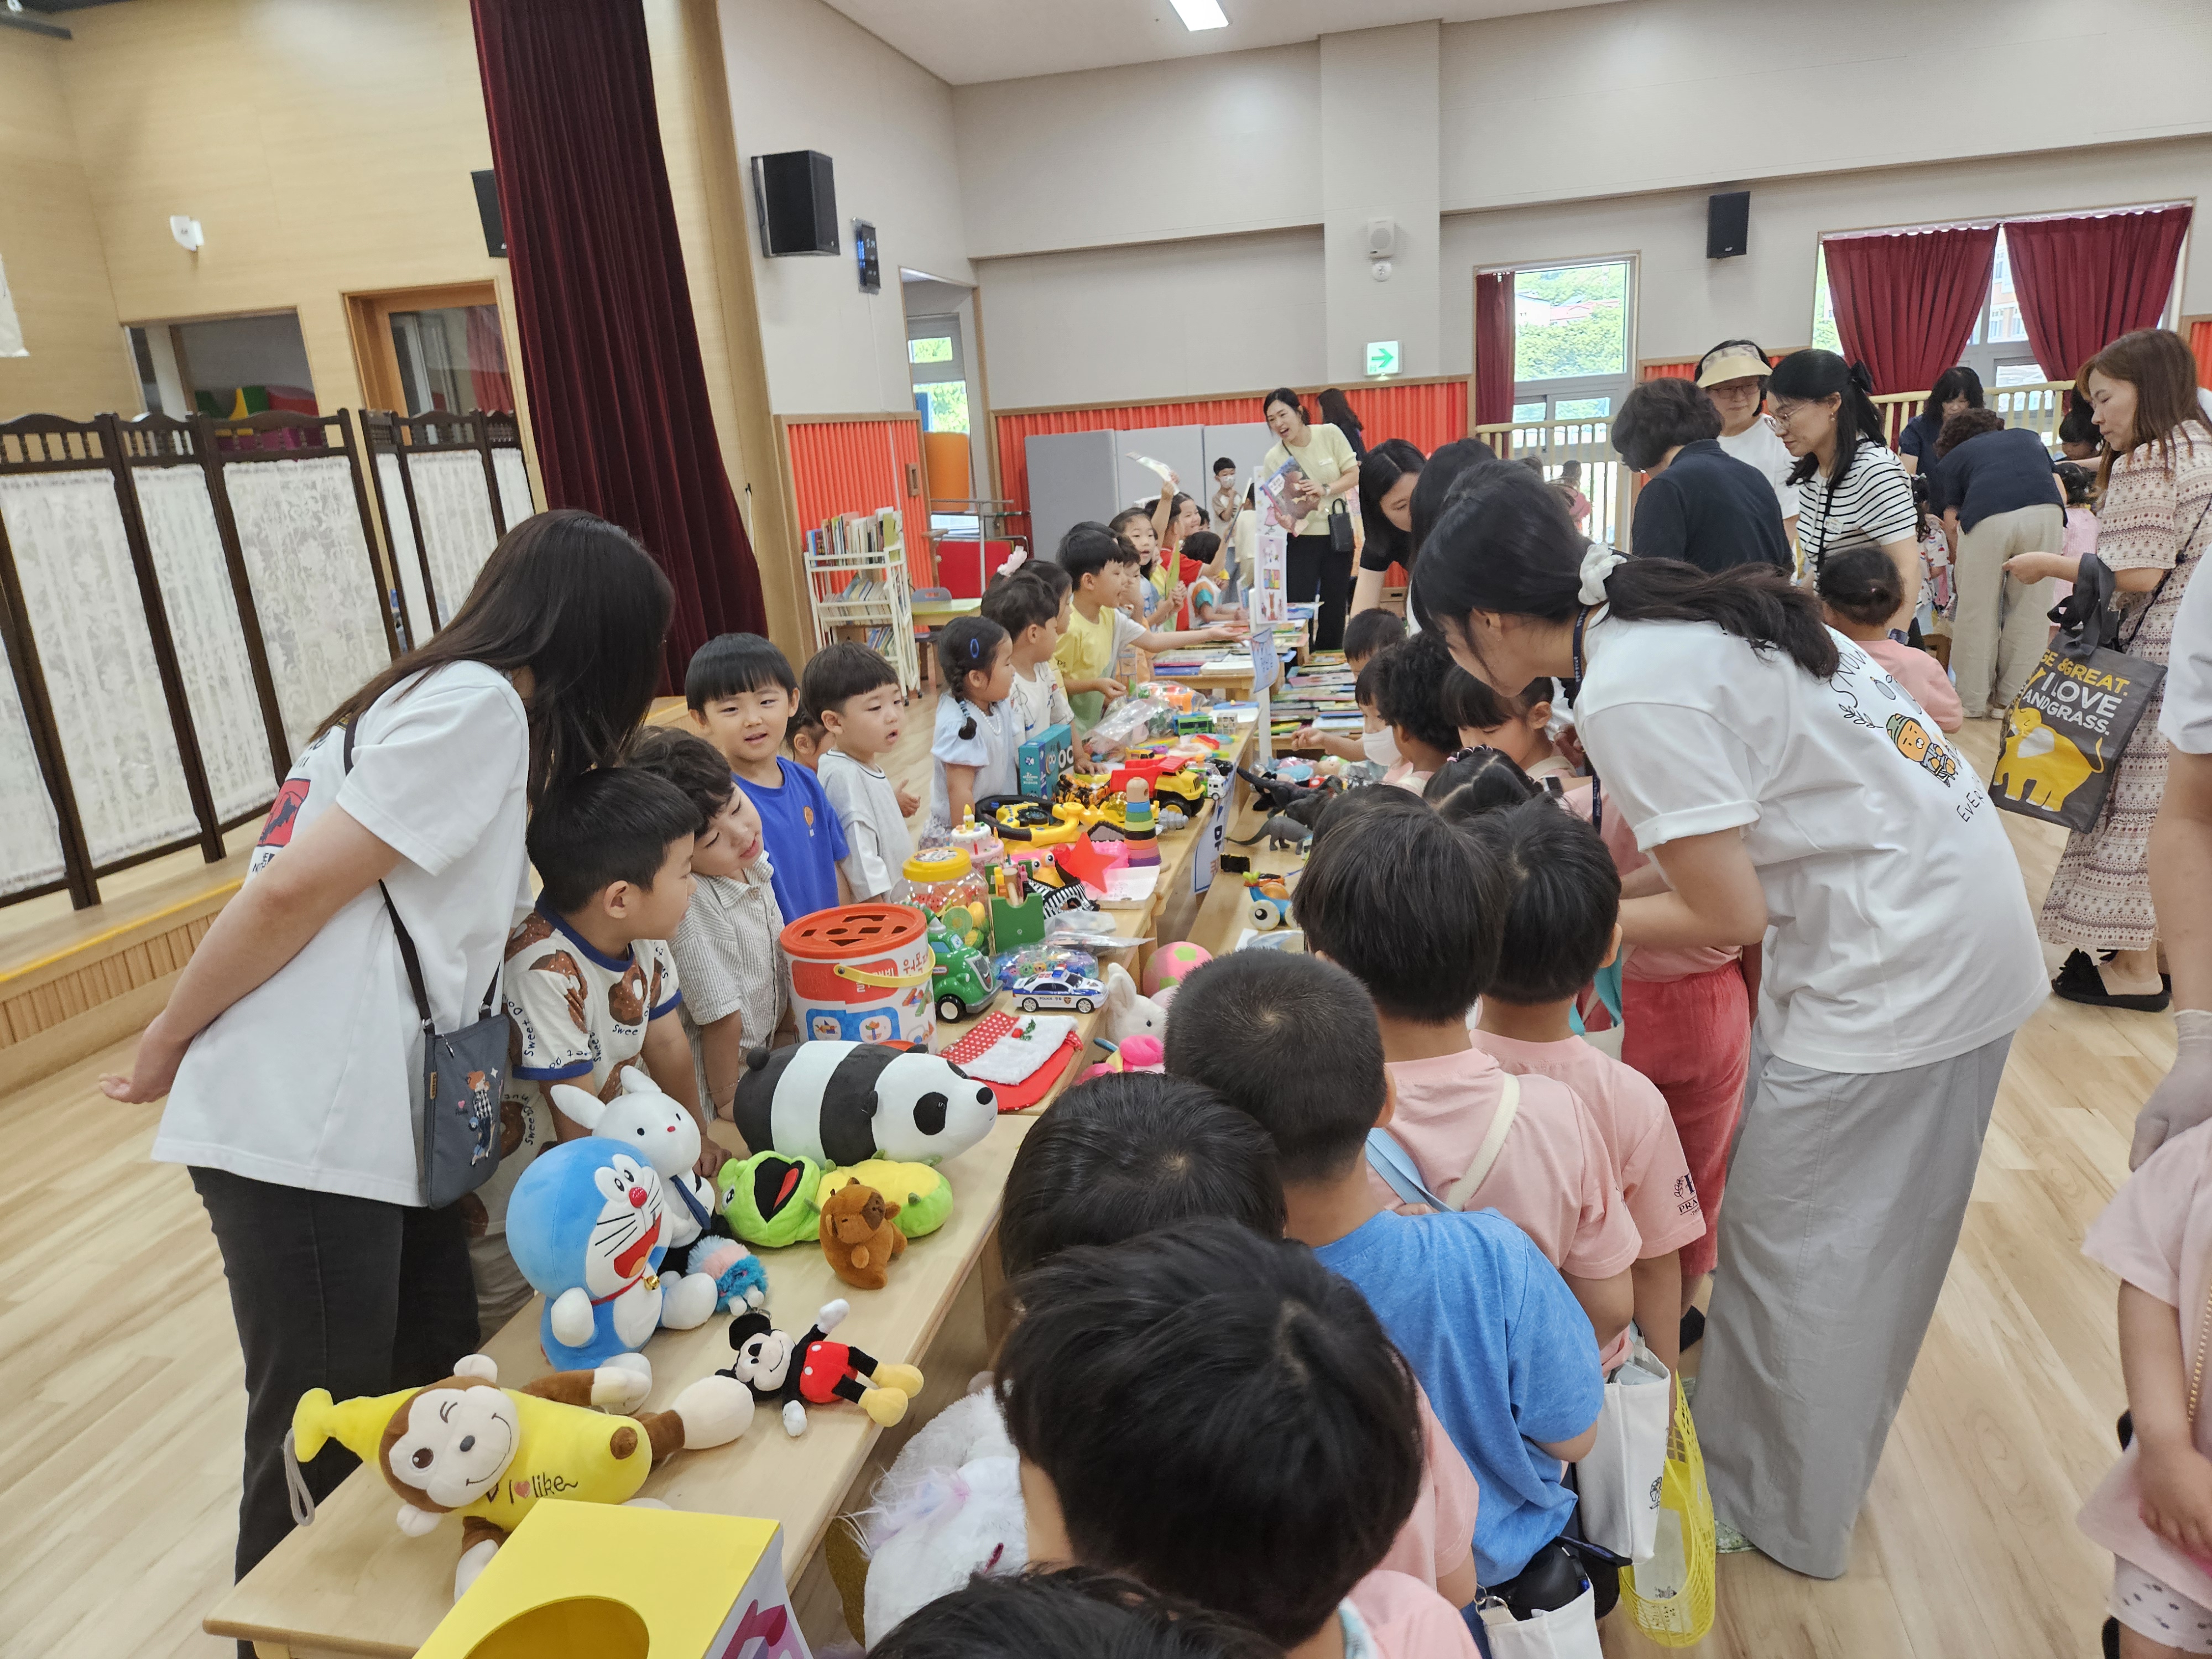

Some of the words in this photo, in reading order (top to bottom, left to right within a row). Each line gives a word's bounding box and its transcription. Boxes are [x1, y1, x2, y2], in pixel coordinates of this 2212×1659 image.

[2041, 672, 2056, 691] I
[522, 1019, 535, 1057] Sweet
[613, 1024, 639, 1036] Swee
